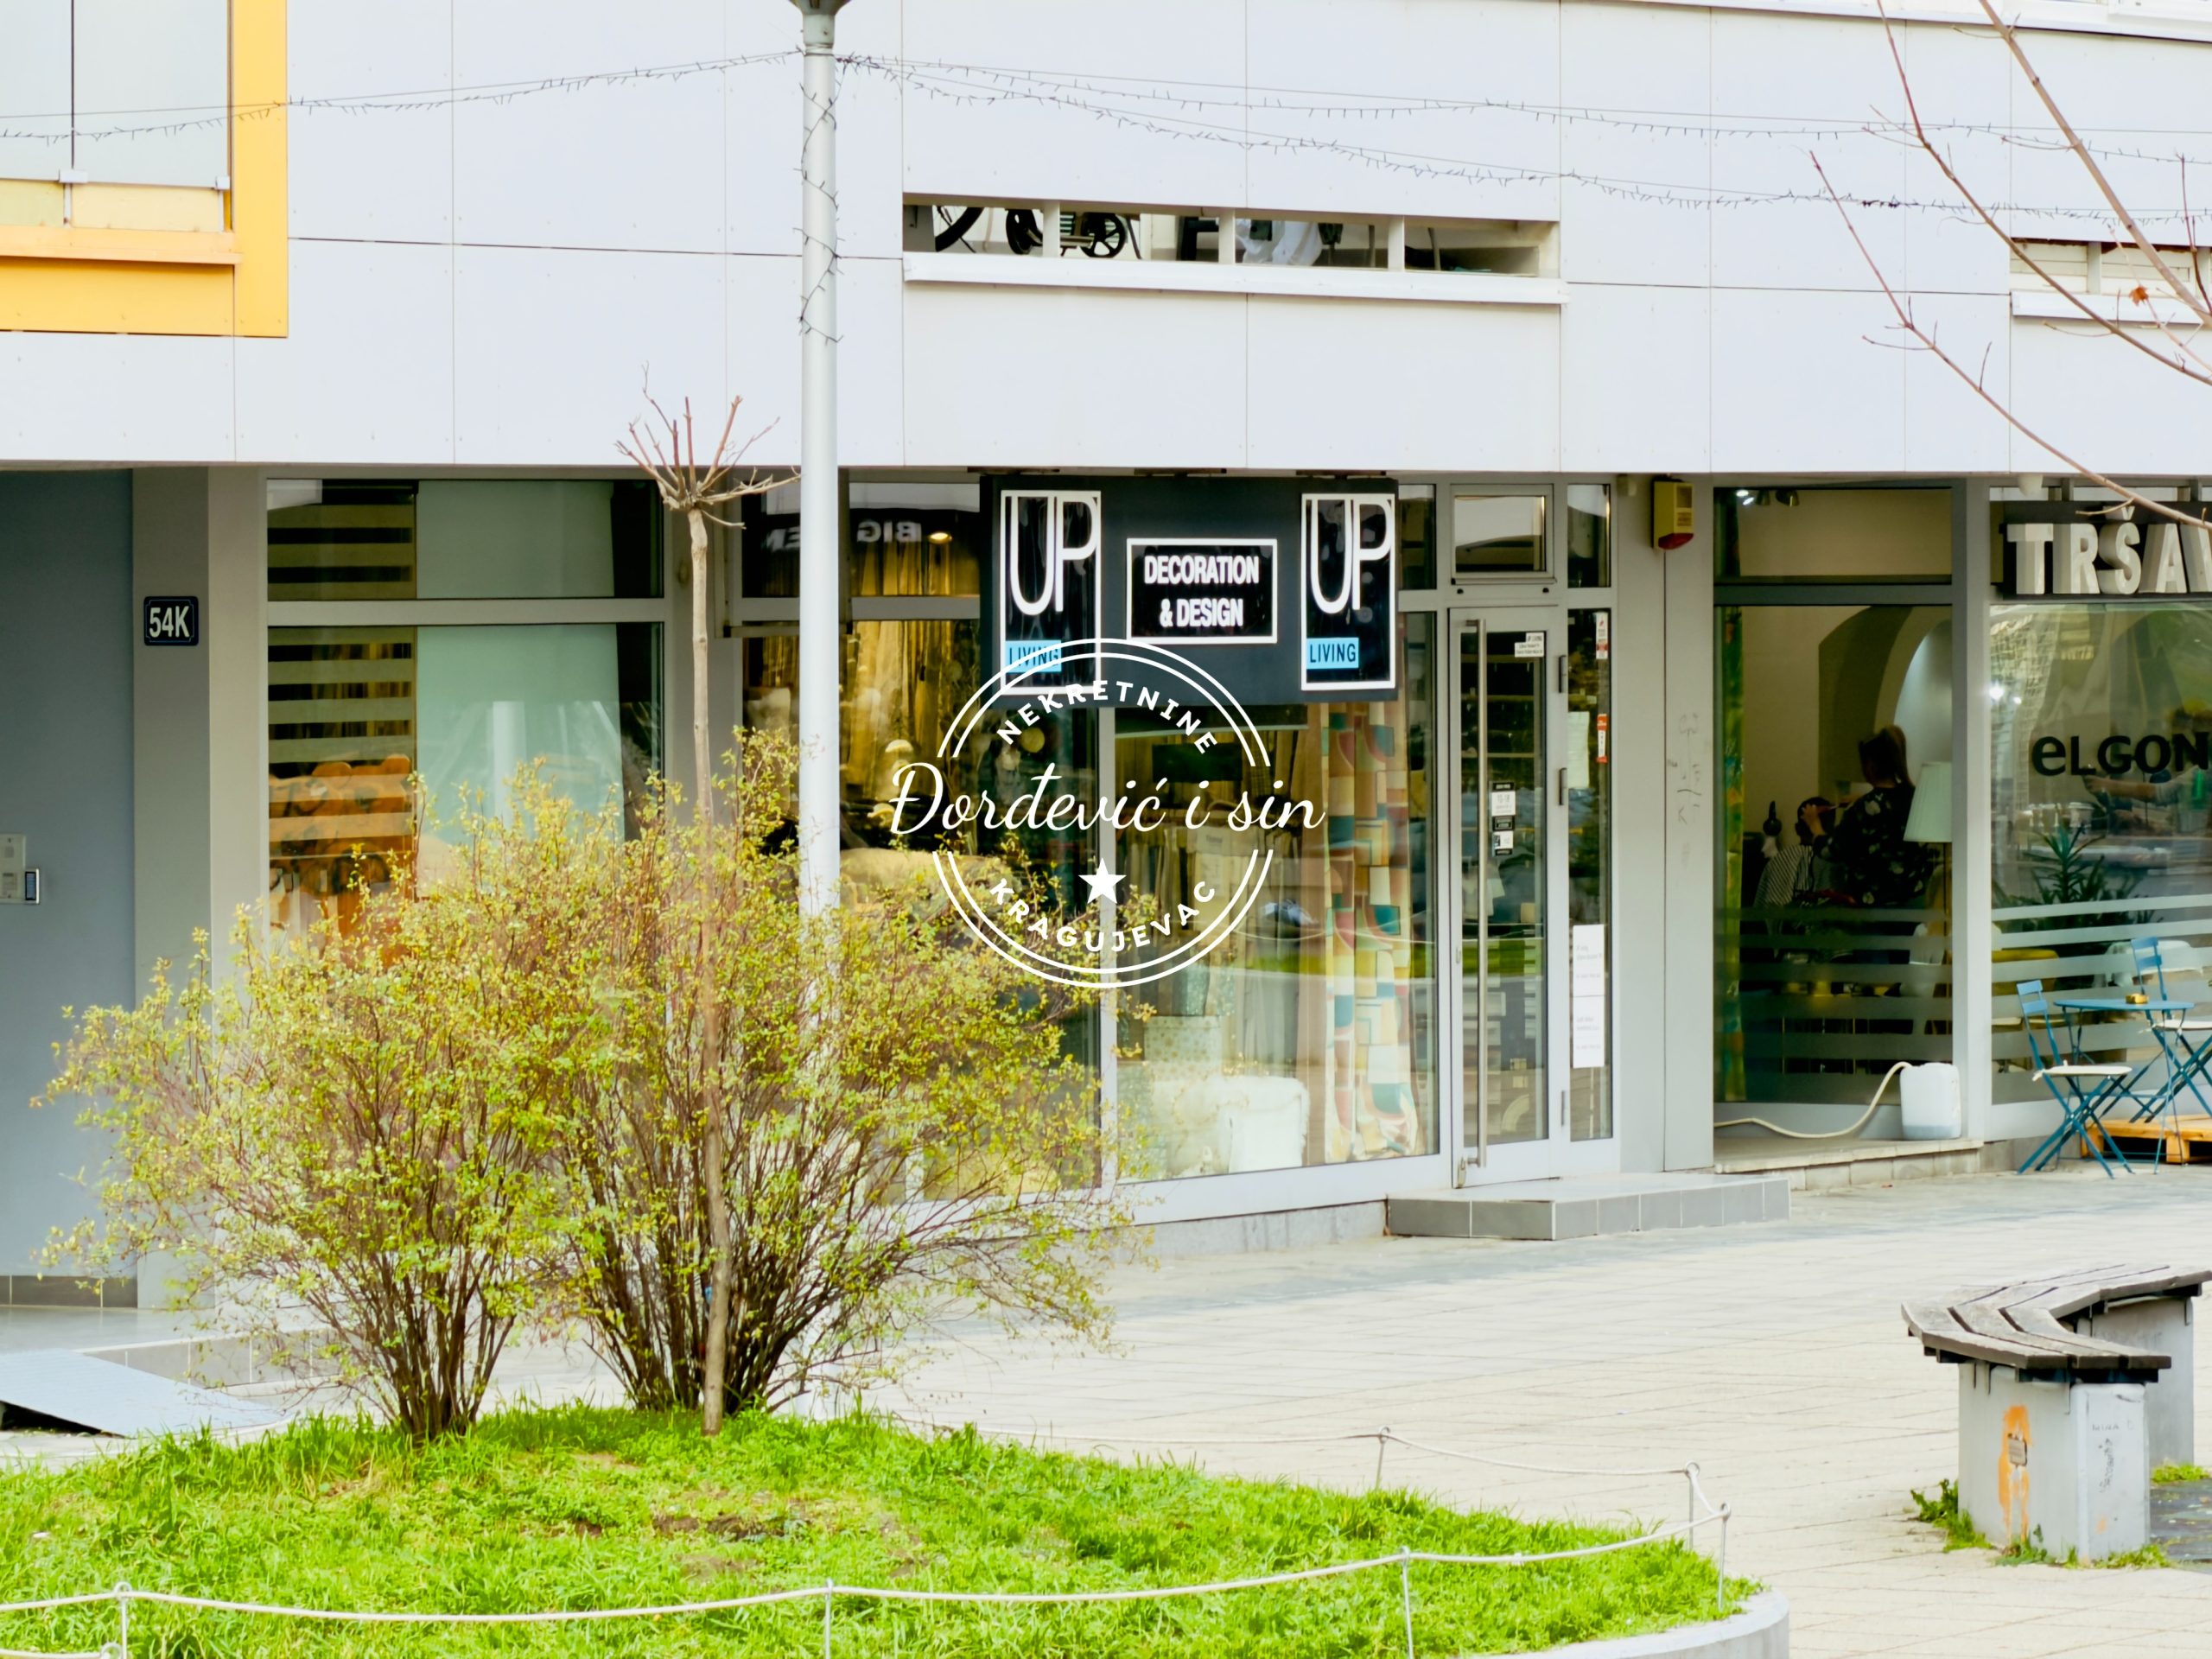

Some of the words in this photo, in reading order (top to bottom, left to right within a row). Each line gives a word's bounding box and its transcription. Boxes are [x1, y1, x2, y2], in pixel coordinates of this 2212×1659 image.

[1009, 491, 1099, 615] UP
[1310, 493, 1393, 614] UP
[1144, 554, 1260, 585] DECORATION
[149, 606, 190, 639] 54K
[1160, 598, 1173, 628] &
[1176, 598, 1243, 627] DESIGN
[1008, 645, 1059, 667] LIVING
[1309, 643, 1357, 664] LIVING
